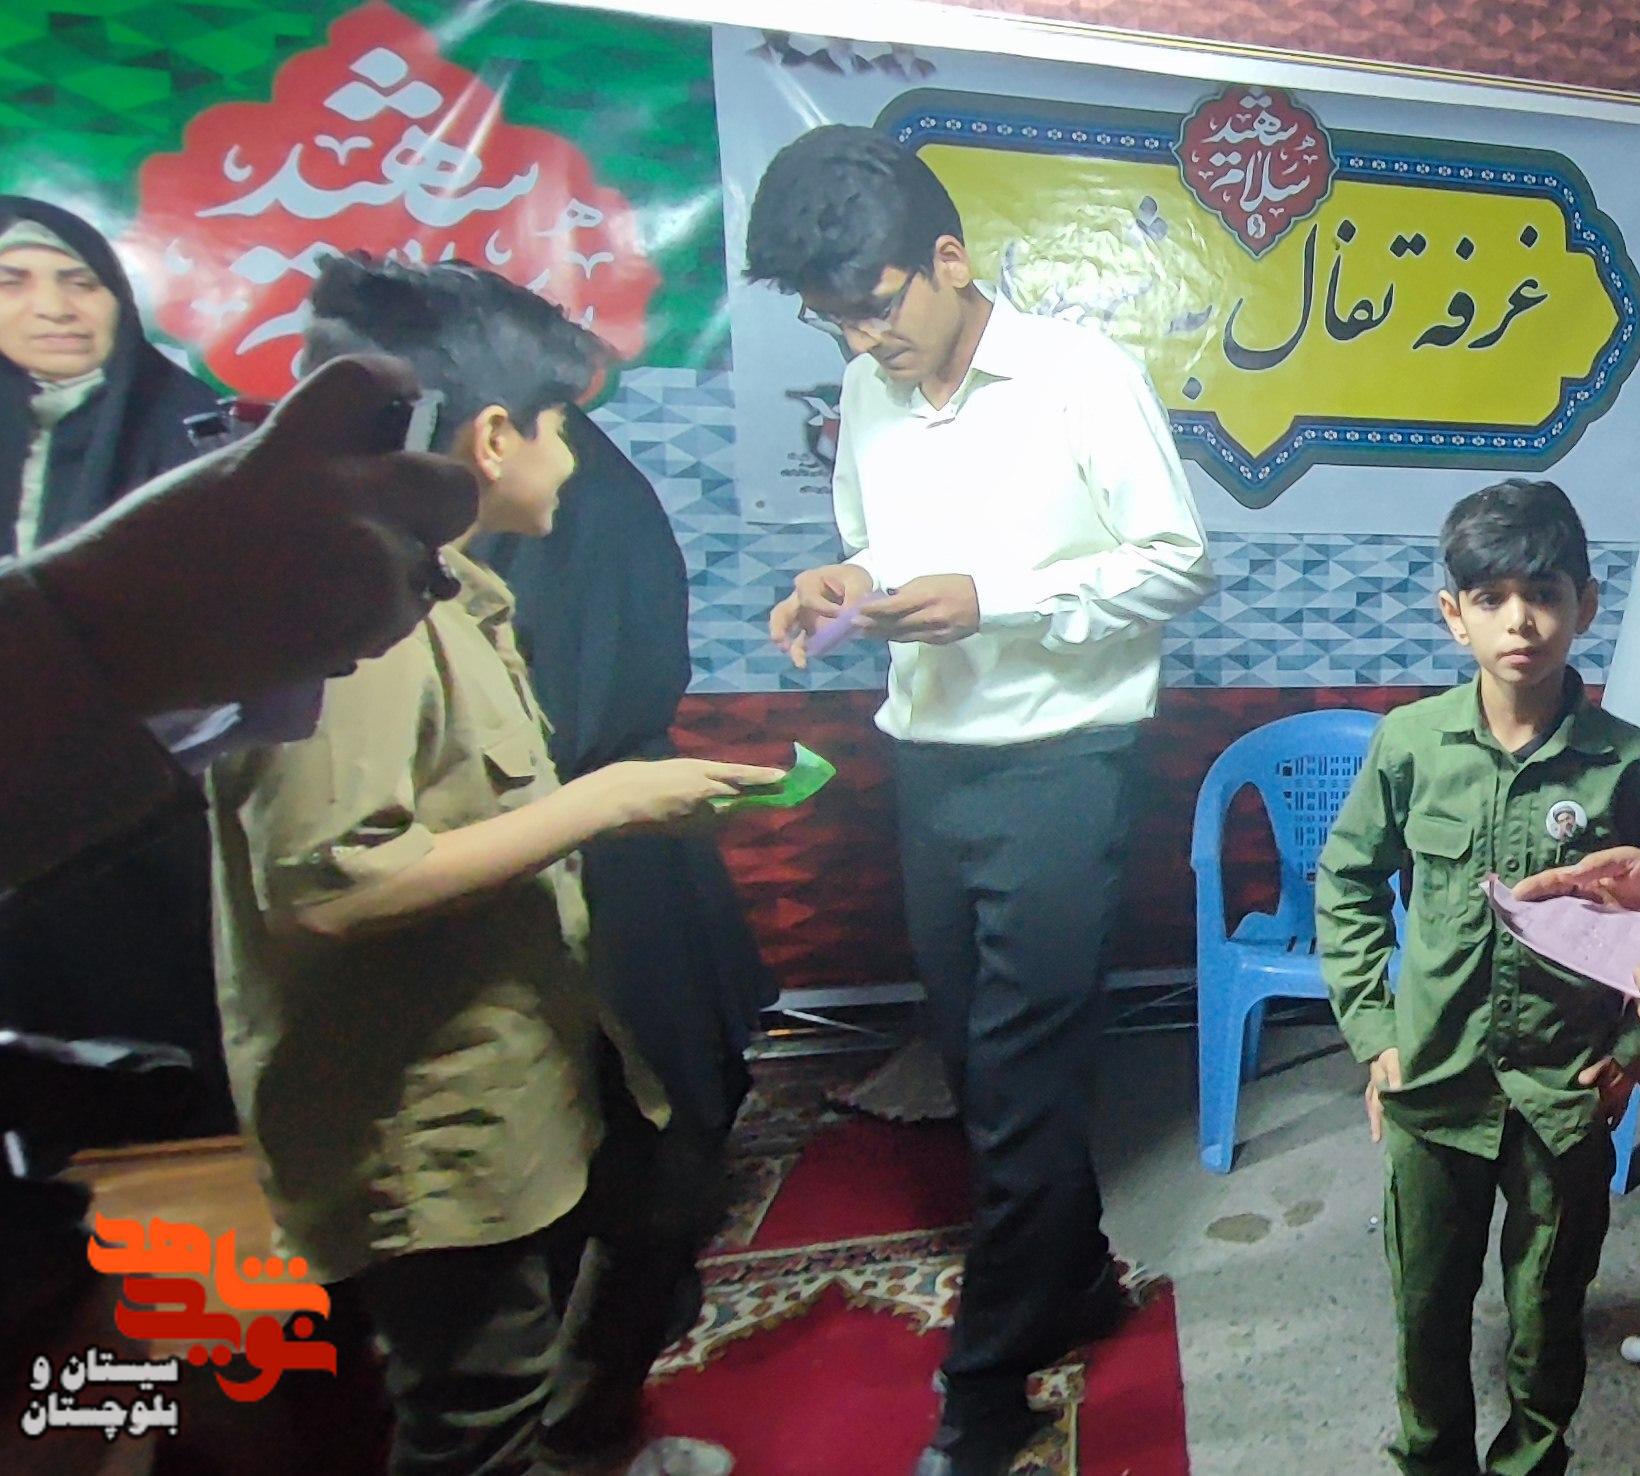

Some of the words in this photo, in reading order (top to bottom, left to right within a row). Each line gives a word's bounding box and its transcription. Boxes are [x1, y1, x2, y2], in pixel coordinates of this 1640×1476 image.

[197, 47, 539, 281] شهید
[1201, 87, 1299, 167] شهید
[1412, 224, 1549, 351] غرفه
